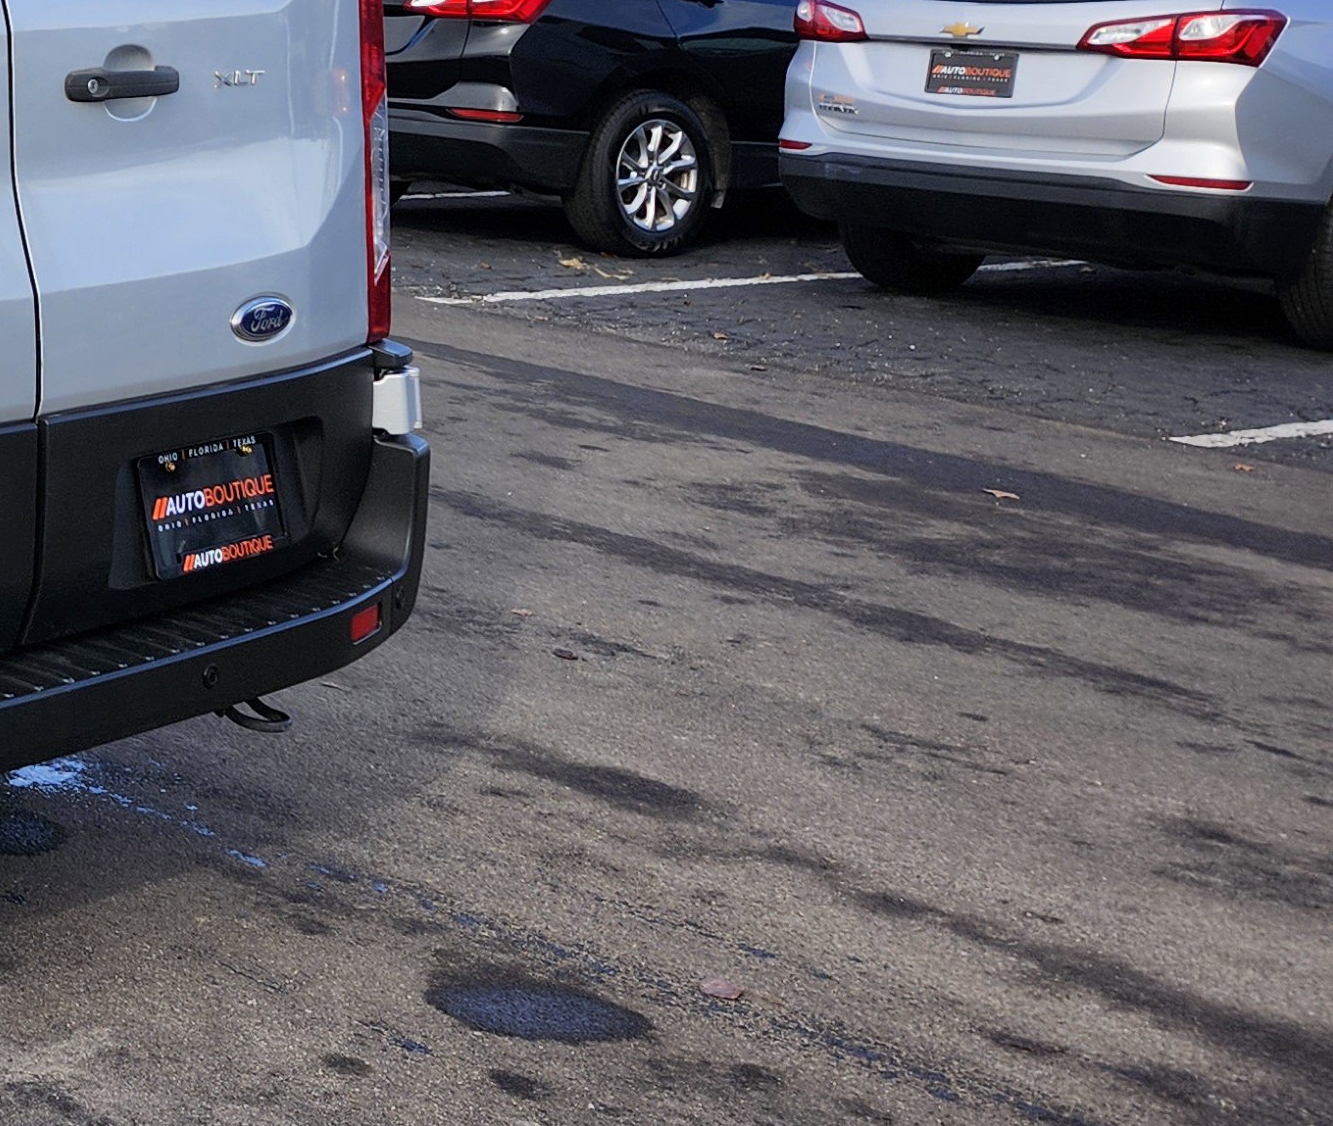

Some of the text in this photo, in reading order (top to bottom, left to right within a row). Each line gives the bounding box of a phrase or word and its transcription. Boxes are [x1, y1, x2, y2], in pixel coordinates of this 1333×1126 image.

[213, 69, 266, 88] XLT
[940, 66, 1012, 78] AUTOBOUTIQUE
[250, 305, 283, 332] Ford
[157, 436, 256, 465] OHIO FLORIDA TEXAS
[165, 474, 275, 517] AUTOBOUTIQUE
[192, 508, 234, 524] FLORIDA
[193, 535, 274, 569] AUTOBOUTIQUE
